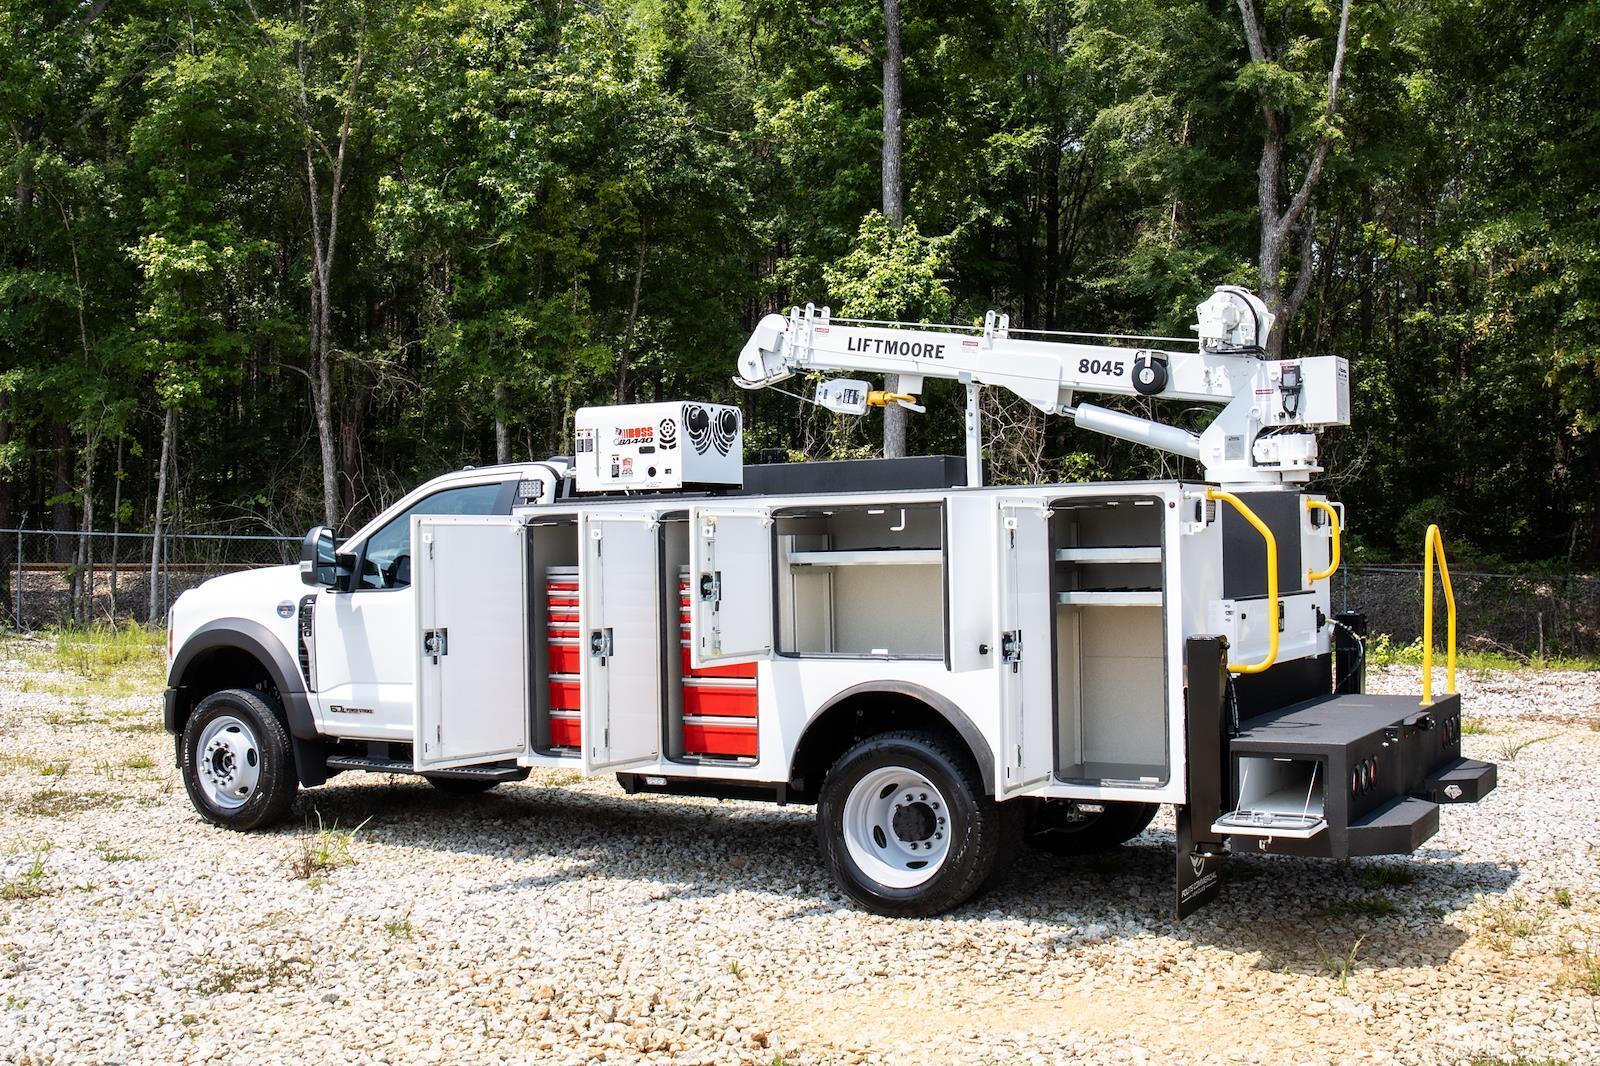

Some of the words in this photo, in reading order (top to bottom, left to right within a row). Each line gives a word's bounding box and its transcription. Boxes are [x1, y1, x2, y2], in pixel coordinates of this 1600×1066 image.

[847, 336, 946, 360] LIFTMOORE
[1078, 358, 1125, 377] 8045
[628, 426, 654, 438] BOSS
